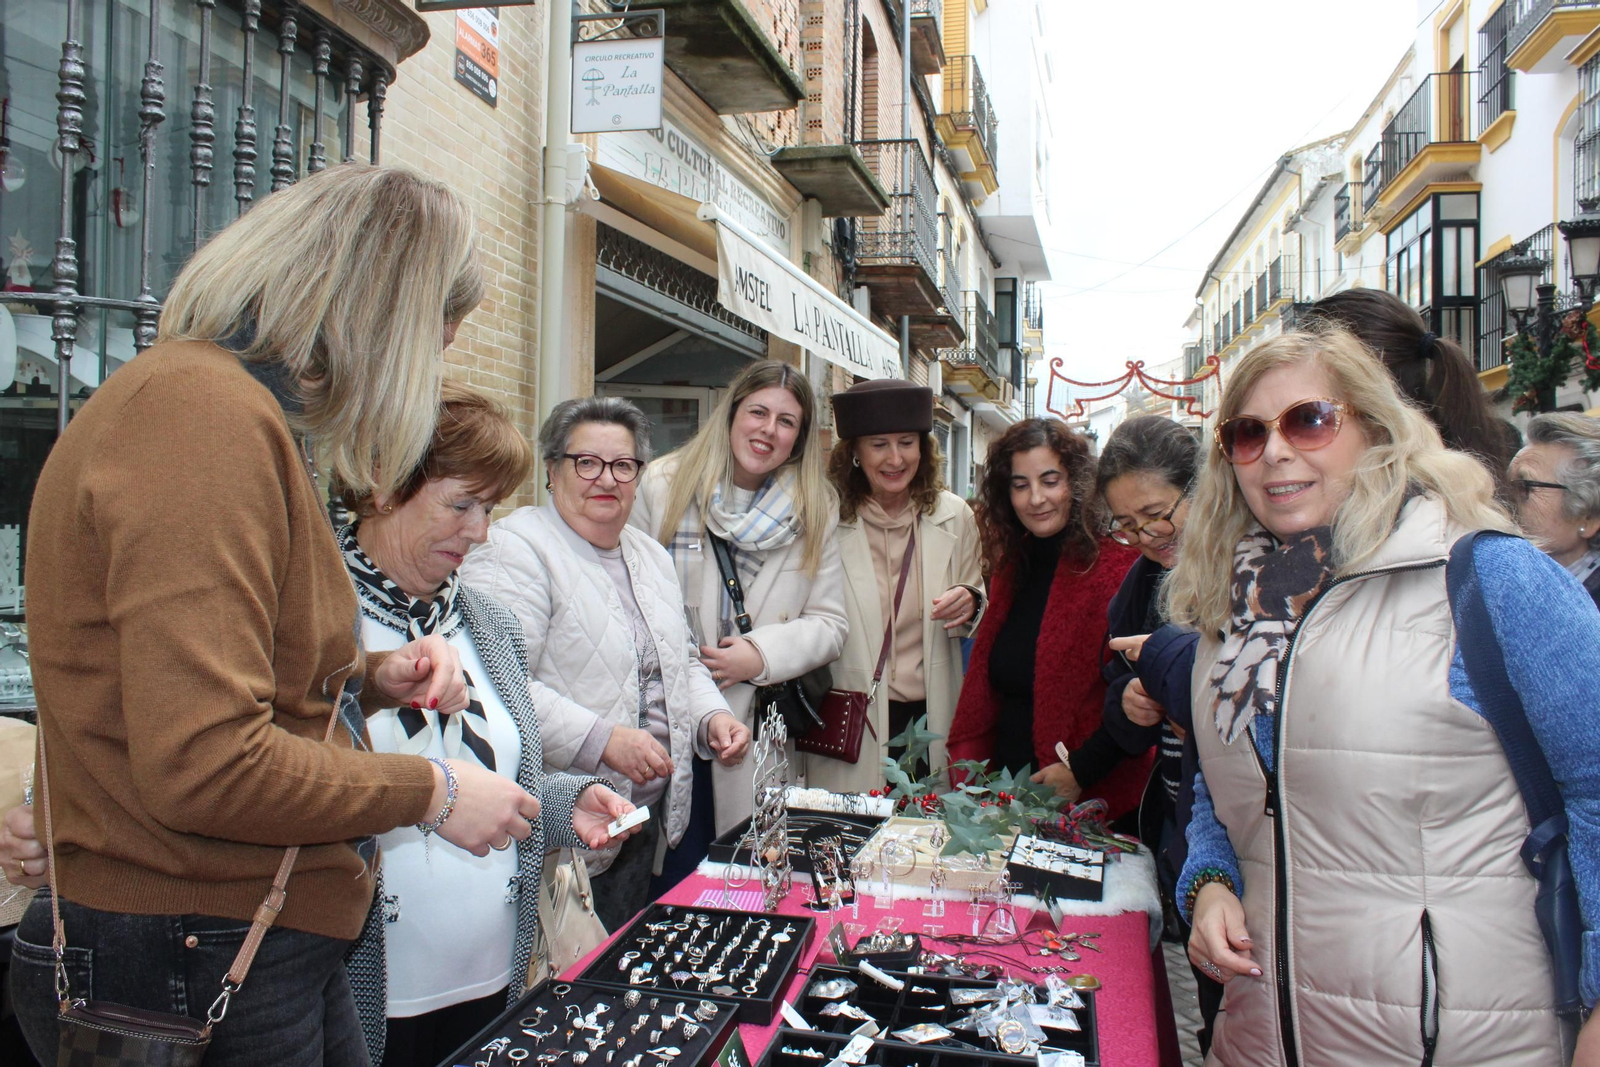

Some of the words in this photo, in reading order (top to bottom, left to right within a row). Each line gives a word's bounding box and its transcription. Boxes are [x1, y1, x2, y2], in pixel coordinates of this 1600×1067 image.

[459, 27, 481, 52] ALARMAS
[481, 43, 496, 67] 365
[584, 54, 613, 63] CIRCULO
[614, 52, 655, 61] RECREATIVO
[602, 83, 656, 98] Pantalla
[620, 65, 638, 79] La
[667, 129, 728, 195] CULTURAL
[730, 180, 786, 239] RECREATIVO
[734, 263, 772, 313] AMSTEL
[791, 291, 813, 339] LA
[813, 305, 874, 371] PANTALLA
